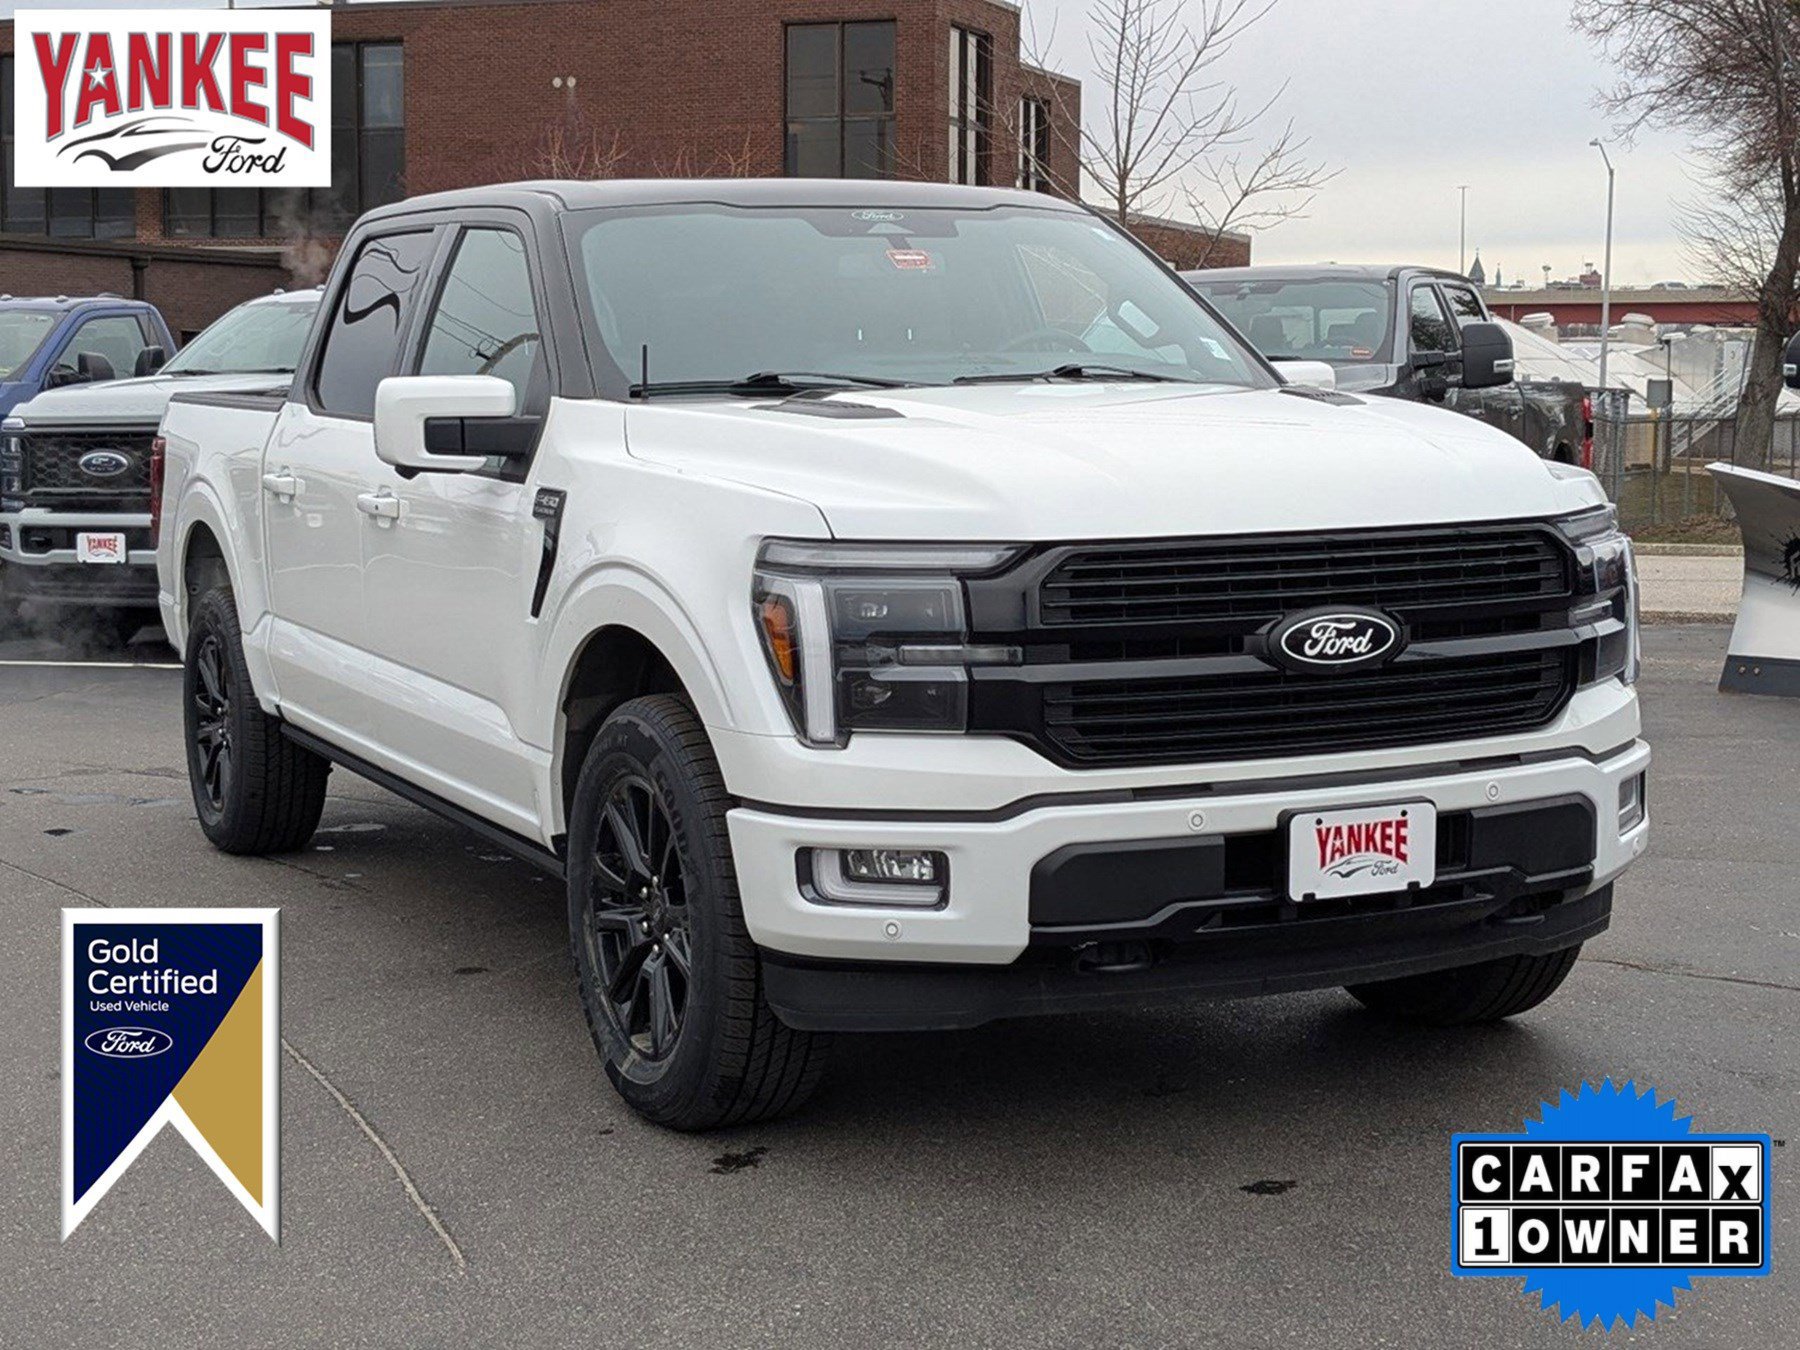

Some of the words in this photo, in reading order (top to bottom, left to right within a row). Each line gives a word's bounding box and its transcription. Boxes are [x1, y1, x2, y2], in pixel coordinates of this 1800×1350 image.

[1303, 622, 1374, 656] Ford
[1315, 819, 1408, 869] YANKEE
[1371, 859, 1399, 876] Ford
